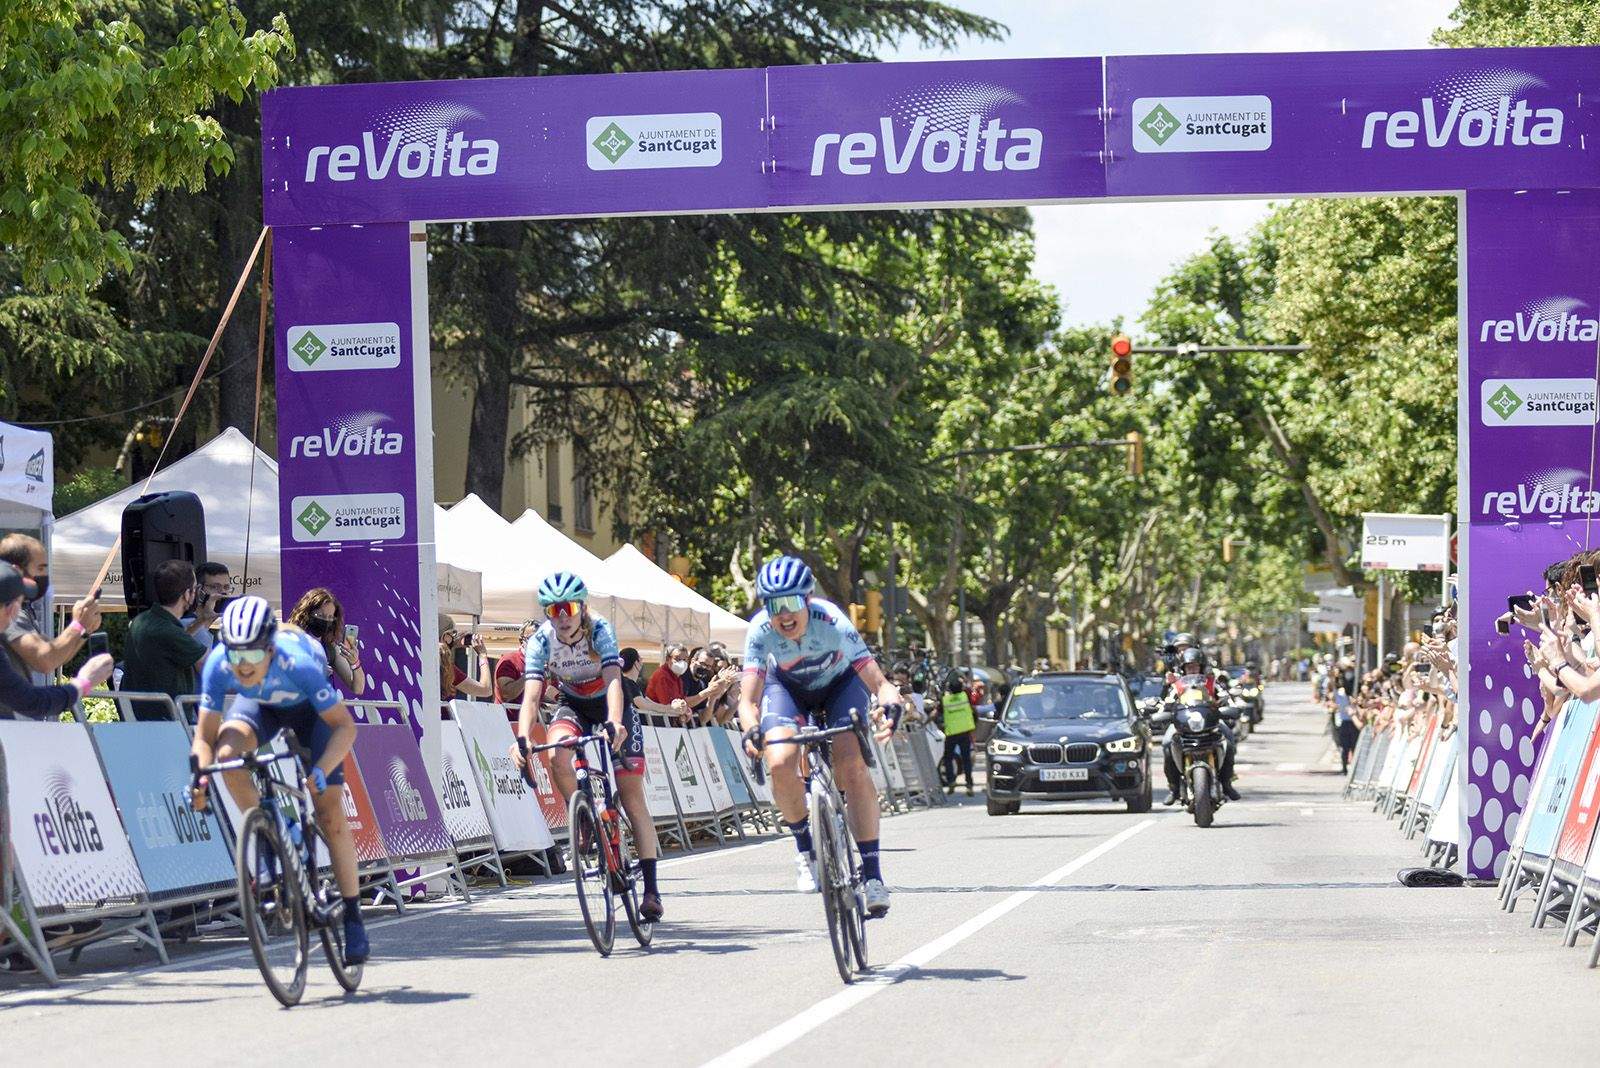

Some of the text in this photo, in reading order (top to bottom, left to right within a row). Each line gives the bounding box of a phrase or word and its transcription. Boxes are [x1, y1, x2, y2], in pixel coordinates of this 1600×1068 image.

[1186, 112, 1266, 122] AJUNTAMENT DE
[1361, 96, 1564, 149] reVolta
[638, 129, 717, 140] AJUNTAMENT DE
[1186, 122, 1267, 138] SantCugat
[638, 139, 717, 154] SantCugat
[810, 112, 1043, 176] reVolta
[305, 127, 499, 183] reVolta
[1480, 311, 1599, 342] reVolta
[330, 336, 396, 346] AJUNTAMENT DE
[330, 345, 396, 358] SantCugat
[1527, 401, 1595, 414] SantCugat
[289, 426, 403, 458] reVolta
[1482, 483, 1600, 514] reVolta
[335, 507, 387, 516] AJUNTAMENT
[335, 515, 400, 528] SantCugat
[1366, 535, 1407, 546] 25 m
[33, 796, 104, 856] reVolta
